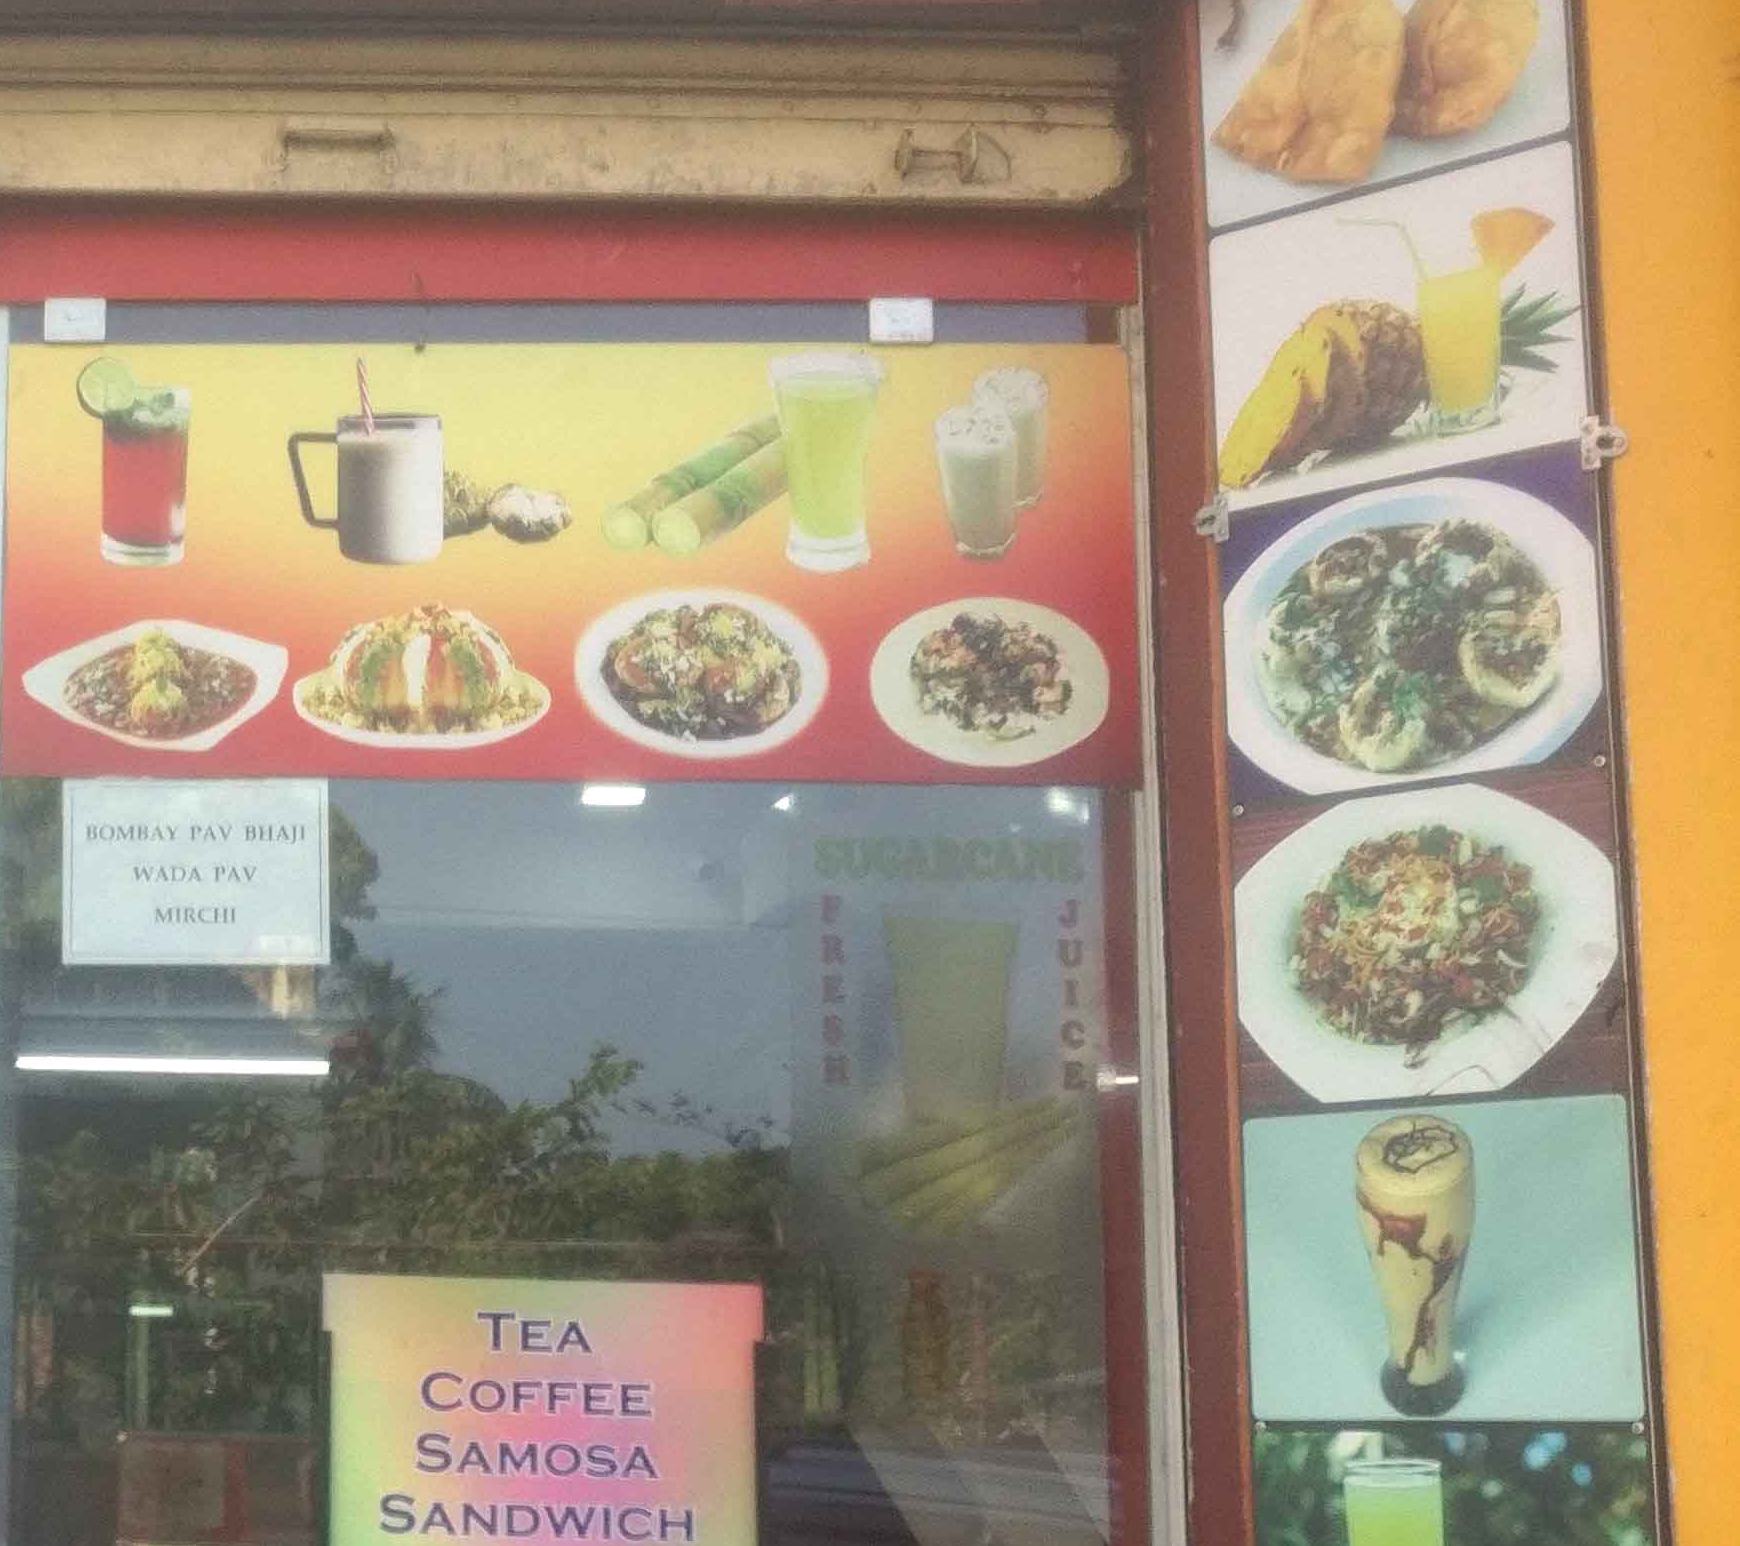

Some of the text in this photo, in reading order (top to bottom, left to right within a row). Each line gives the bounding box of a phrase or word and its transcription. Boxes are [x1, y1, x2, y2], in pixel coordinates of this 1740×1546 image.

[86, 824, 306, 844] BOMBAY PAV BHAJI
[133, 866, 257, 882] WADA PAV
[155, 907, 237, 924] MIRCHI
[820, 894, 850, 1087] FRESH
[1057, 899, 1089, 1091] JUICE
[477, 1312, 592, 1353] TEA
[420, 1371, 652, 1417] COFFEE
[415, 1433, 659, 1480] SAMOSA
[378, 1493, 694, 1542] SANDWICH
